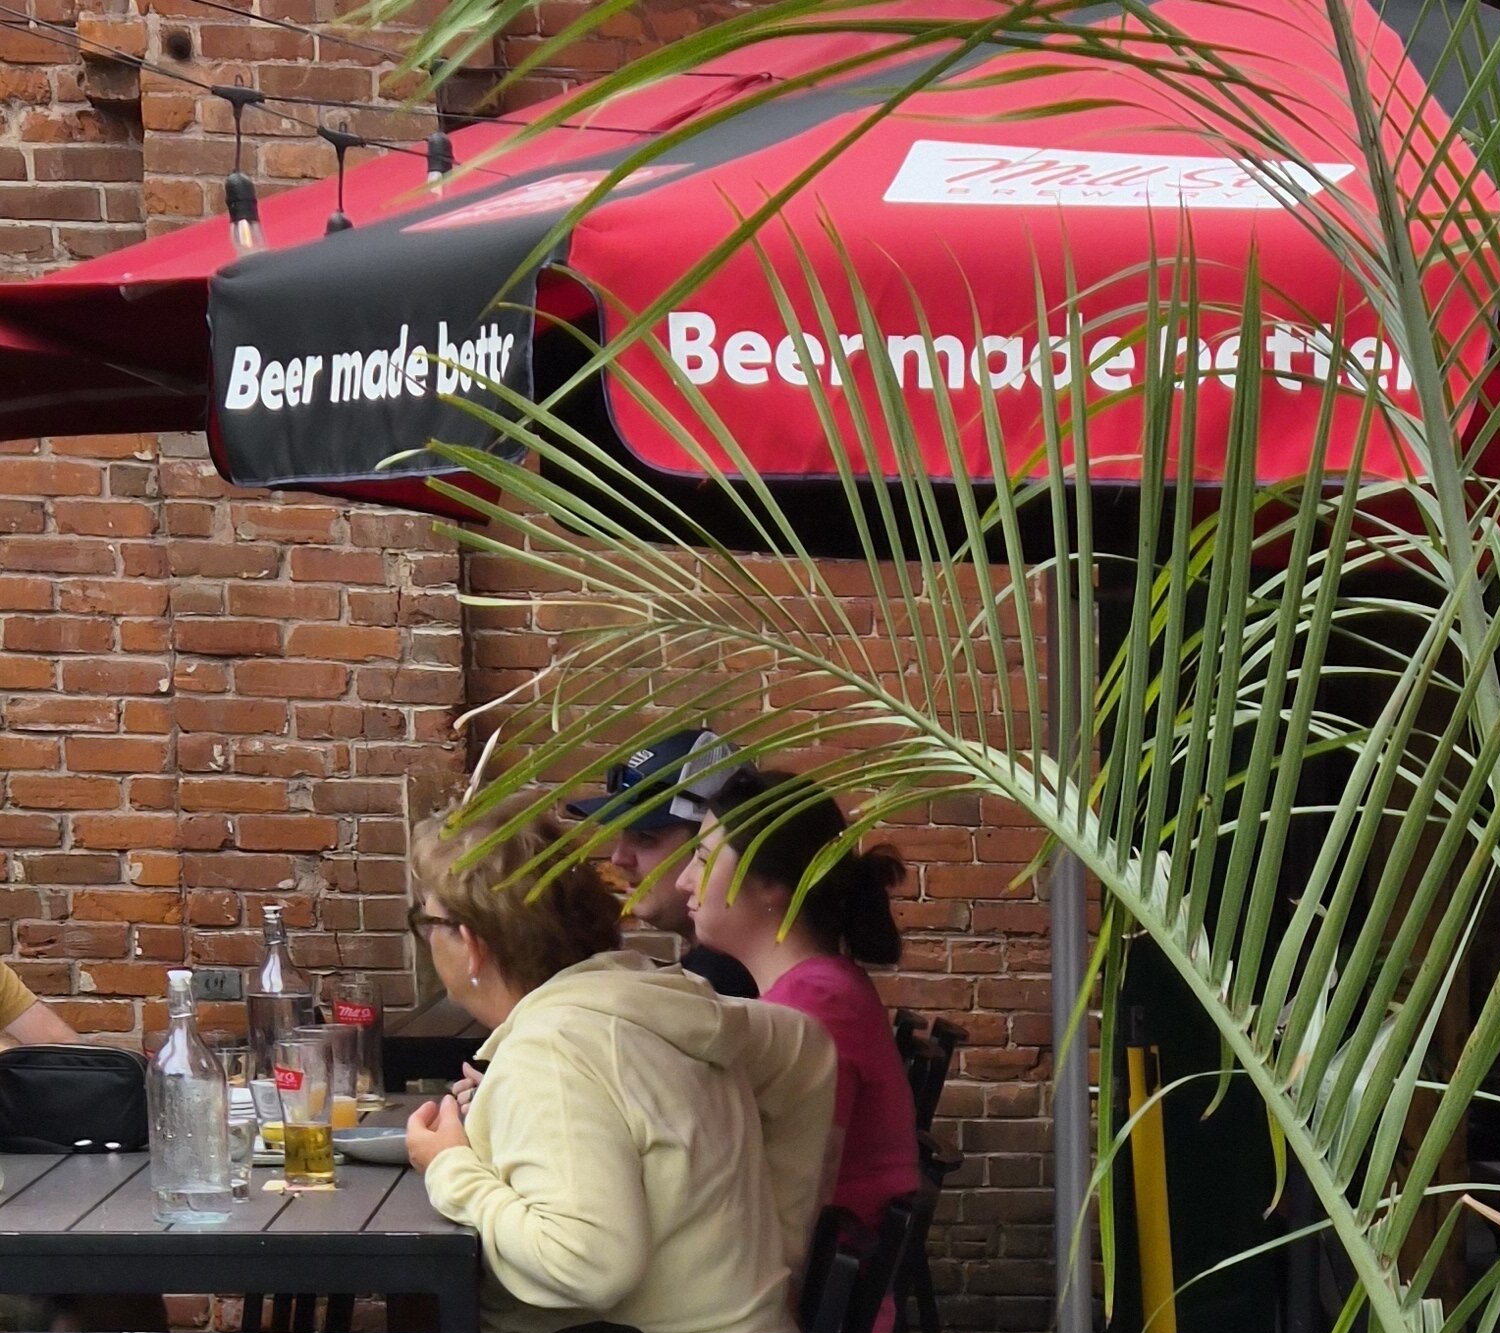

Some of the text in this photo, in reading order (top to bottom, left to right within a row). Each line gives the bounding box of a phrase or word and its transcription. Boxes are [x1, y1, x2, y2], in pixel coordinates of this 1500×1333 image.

[943, 157, 1169, 186] Mill
[224, 345, 323, 411] Beer
[329, 323, 429, 404] made
[667, 311, 865, 386] Beer
[887, 312, 1136, 391] made
